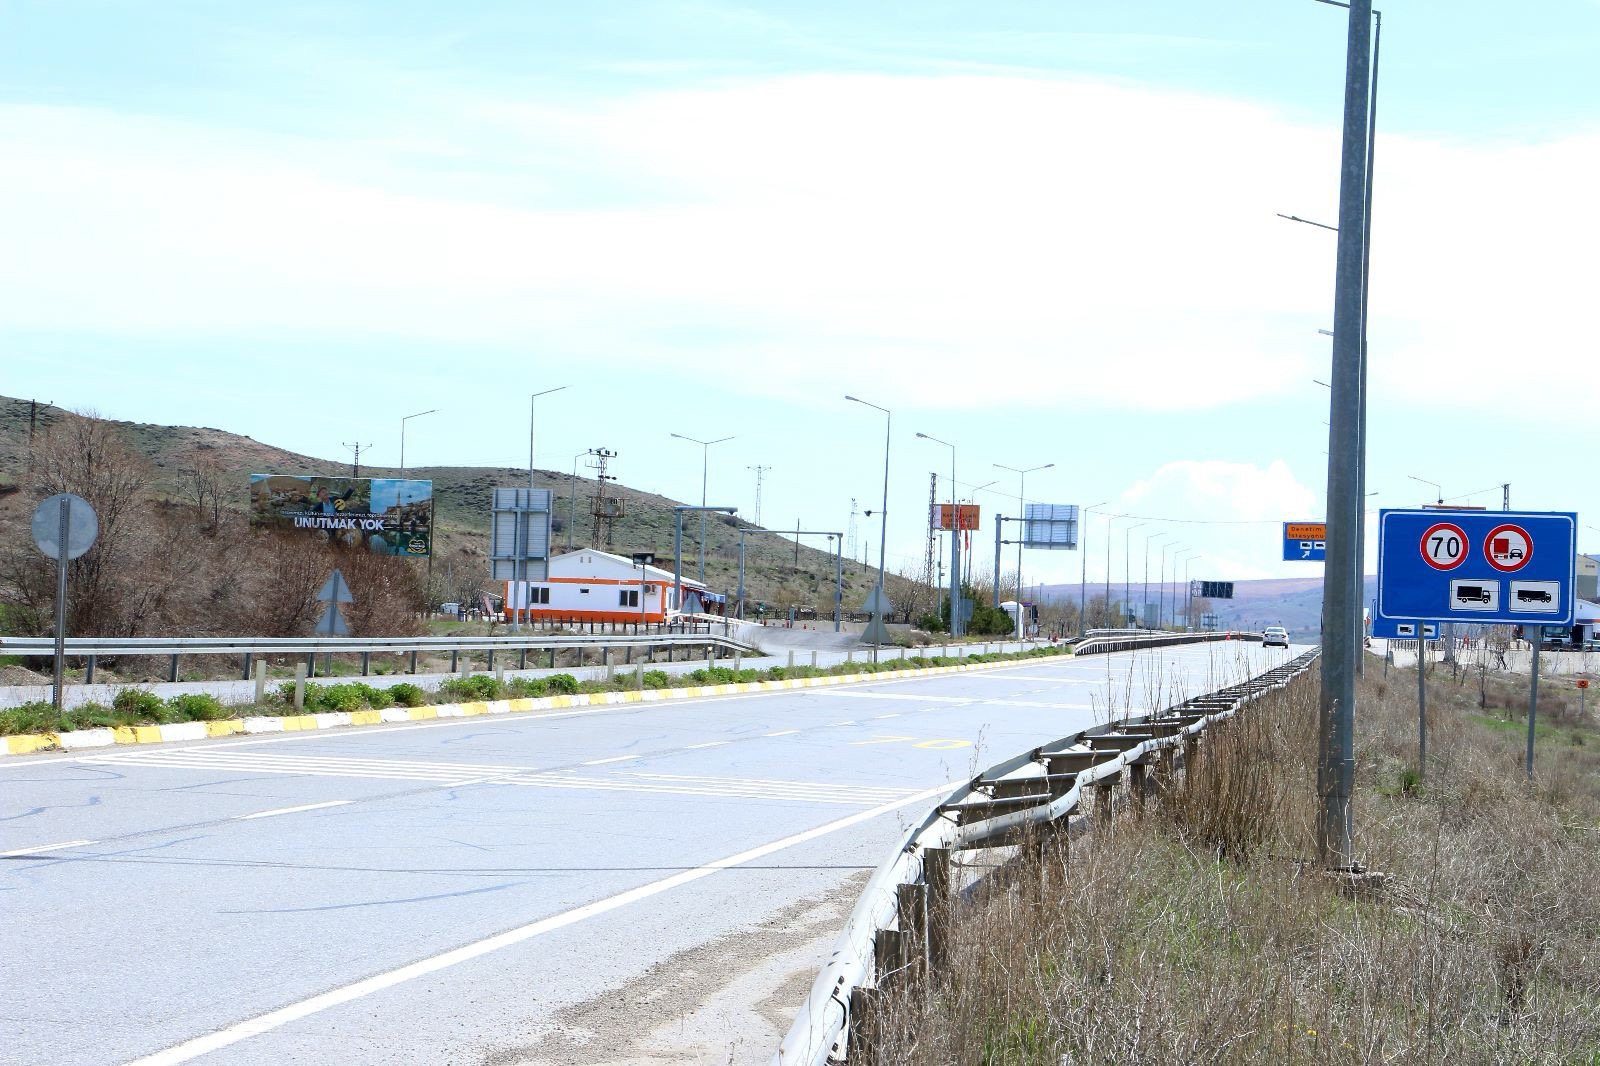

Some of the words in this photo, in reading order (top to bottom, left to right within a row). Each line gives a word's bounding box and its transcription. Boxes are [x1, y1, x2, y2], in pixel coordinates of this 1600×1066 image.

[294, 517, 356, 529] UNUTMAK
[359, 519, 384, 530] YOK
[1431, 536, 1460, 557] 70
